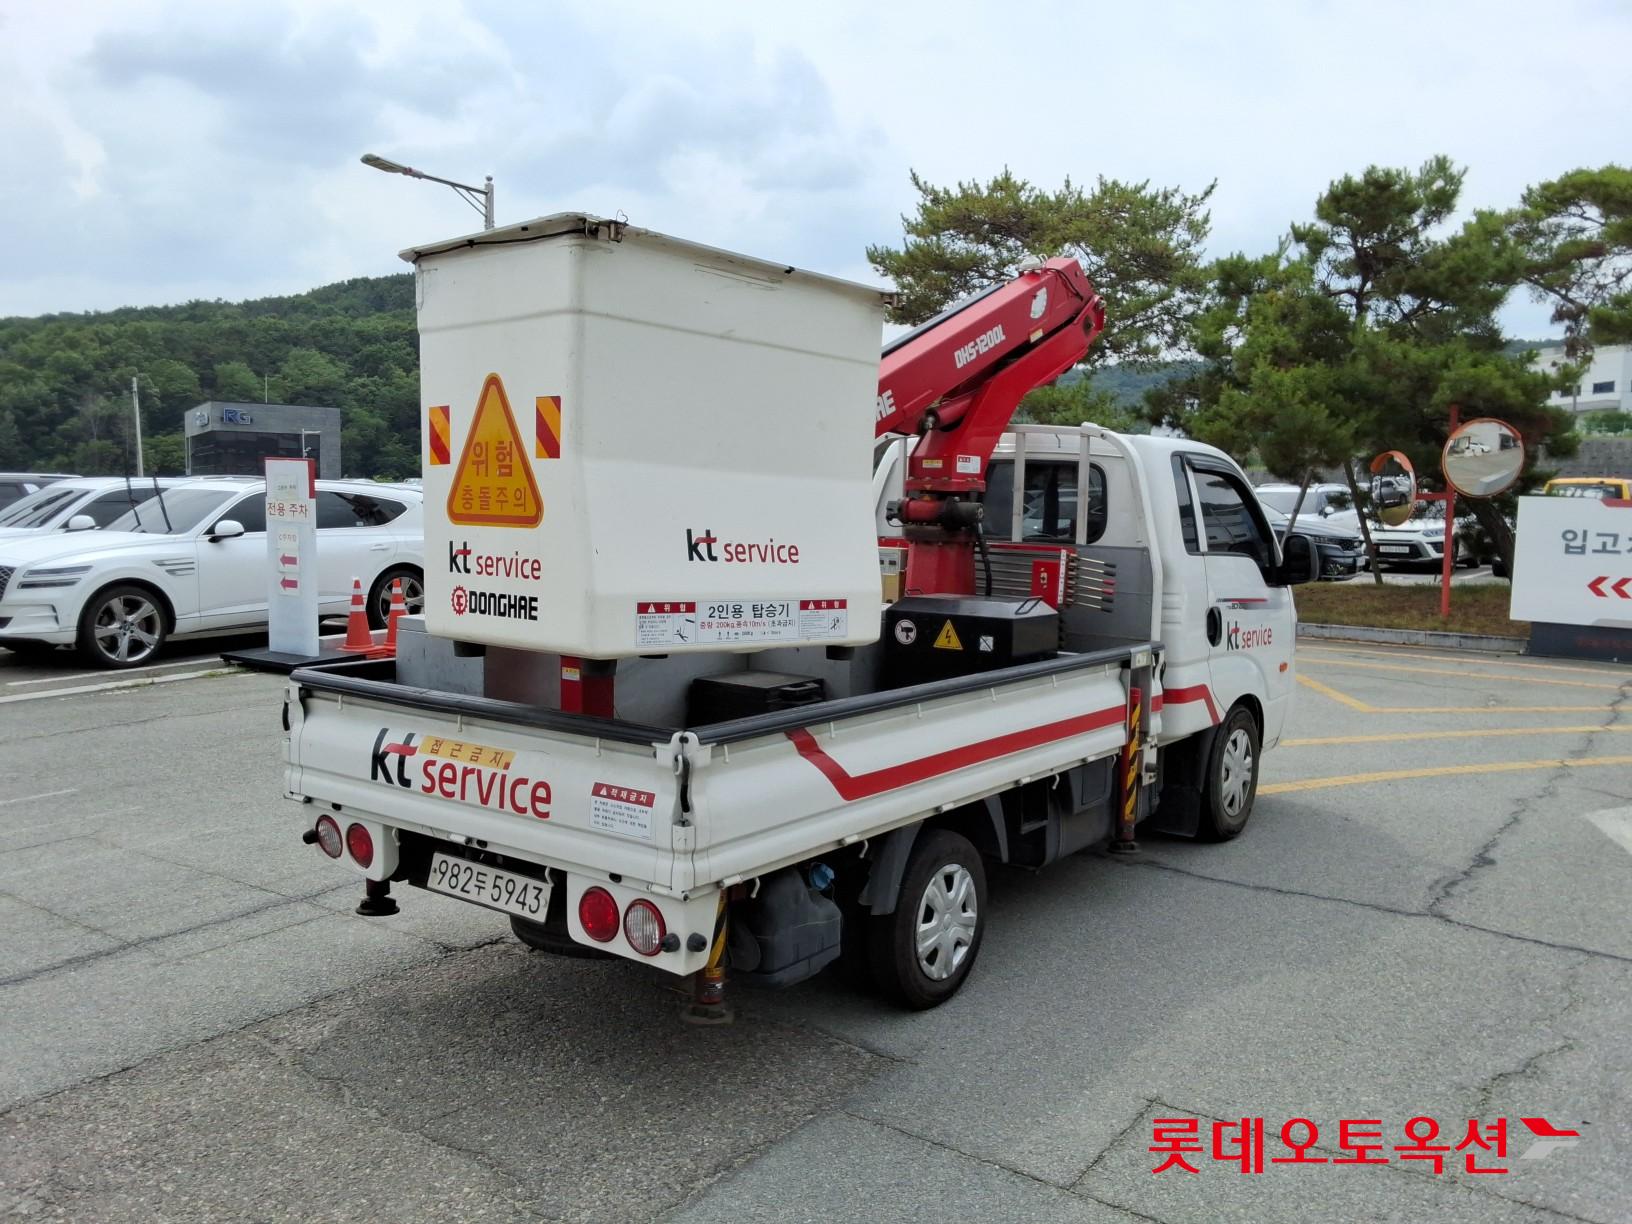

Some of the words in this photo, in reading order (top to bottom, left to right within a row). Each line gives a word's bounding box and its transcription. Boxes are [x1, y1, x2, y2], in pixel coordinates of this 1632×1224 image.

[954, 324, 1006, 369] DHS-1200L
[472, 440, 513, 477] 위험
[267, 502, 286, 517] 전용
[289, 503, 308, 519] 주차
[462, 485, 527, 512] 충돌주의
[449, 541, 472, 574] kt
[475, 551, 542, 580] service
[687, 528, 719, 561] kt
[724, 538, 799, 564] service
[468, 590, 538, 621] DONGHAE
[708, 603, 744, 619] 2인용
[752, 602, 790, 618] 탑승기
[1227, 620, 1240, 651] kt
[1242, 624, 1273, 649] service
[429, 739, 504, 767] 접근금지
[371, 728, 418, 788] kt
[421, 760, 552, 819] service
